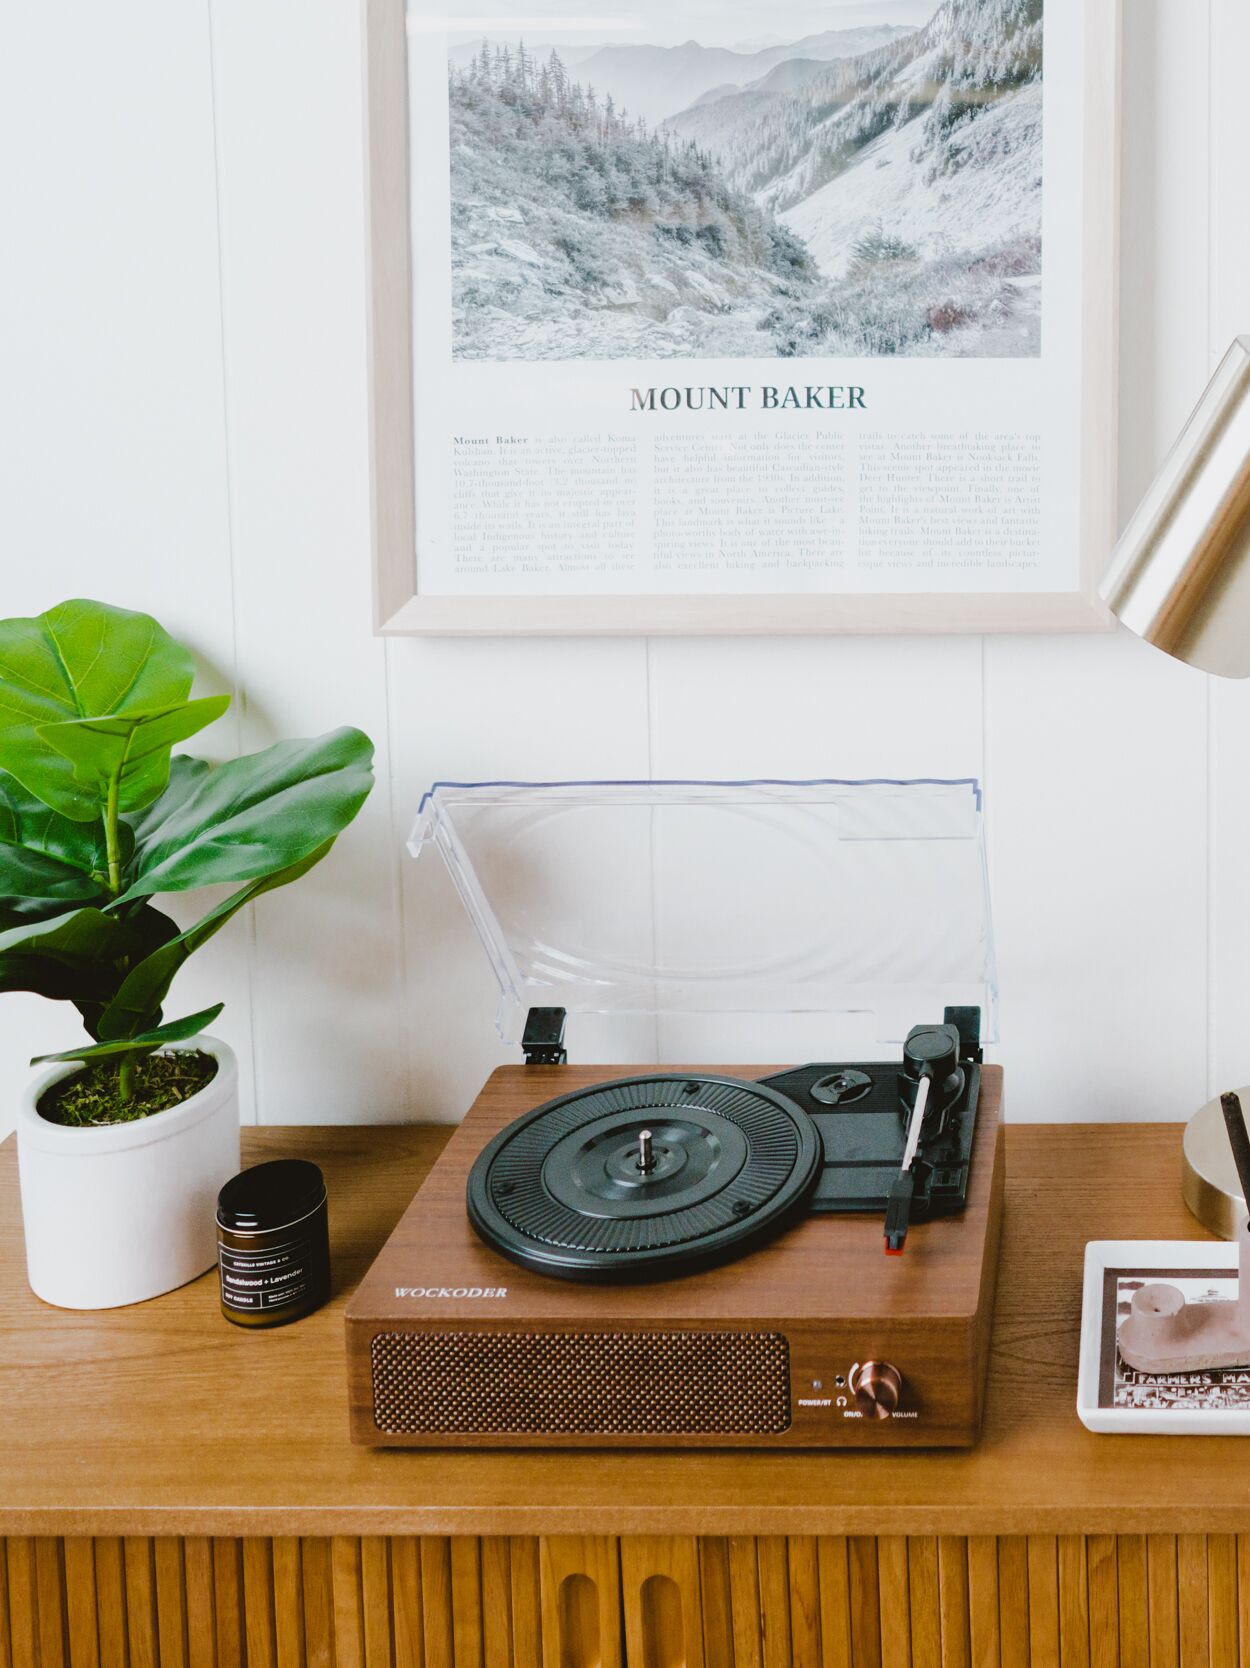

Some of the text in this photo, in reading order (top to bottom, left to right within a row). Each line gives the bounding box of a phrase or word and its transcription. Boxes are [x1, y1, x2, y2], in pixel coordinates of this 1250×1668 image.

[629, 386, 868, 411] MOUNT BAKER
[452, 436, 489, 445] Mount
[495, 435, 528, 444] Baker
[270, 1268, 303, 1284] Lavender
[395, 1287, 507, 1298] WOCKODER
[1138, 1373, 1213, 1385] FARMERS
[843, 1410, 864, 1418] ON/O
